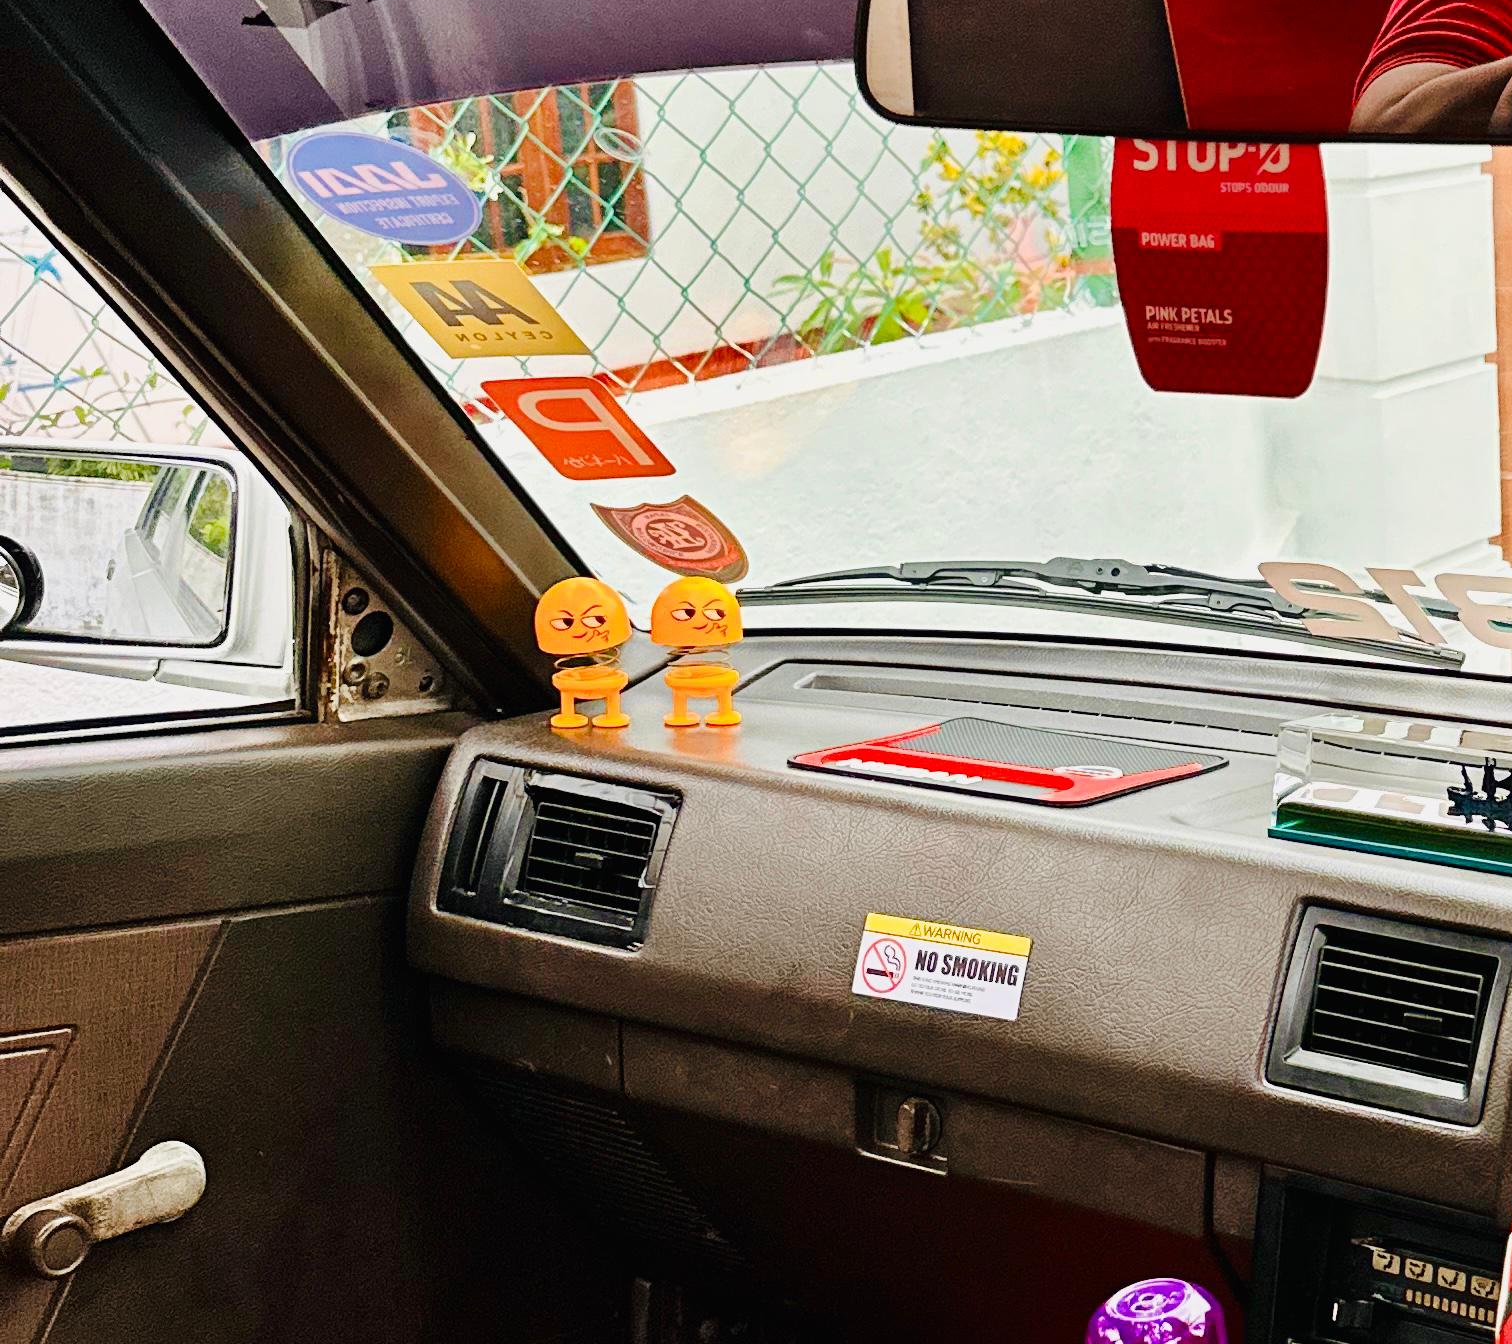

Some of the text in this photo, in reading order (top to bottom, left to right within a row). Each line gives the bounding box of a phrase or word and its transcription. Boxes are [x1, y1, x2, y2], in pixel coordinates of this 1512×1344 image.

[1219, 181, 1252, 194] STOPS
[1141, 232, 1216, 250] POWER BAG
[1144, 304, 1234, 326] PINK PETALS
[922, 923, 982, 945] WARNING
[914, 949, 940, 973] NO
[940, 953, 1020, 986] SMOKING
